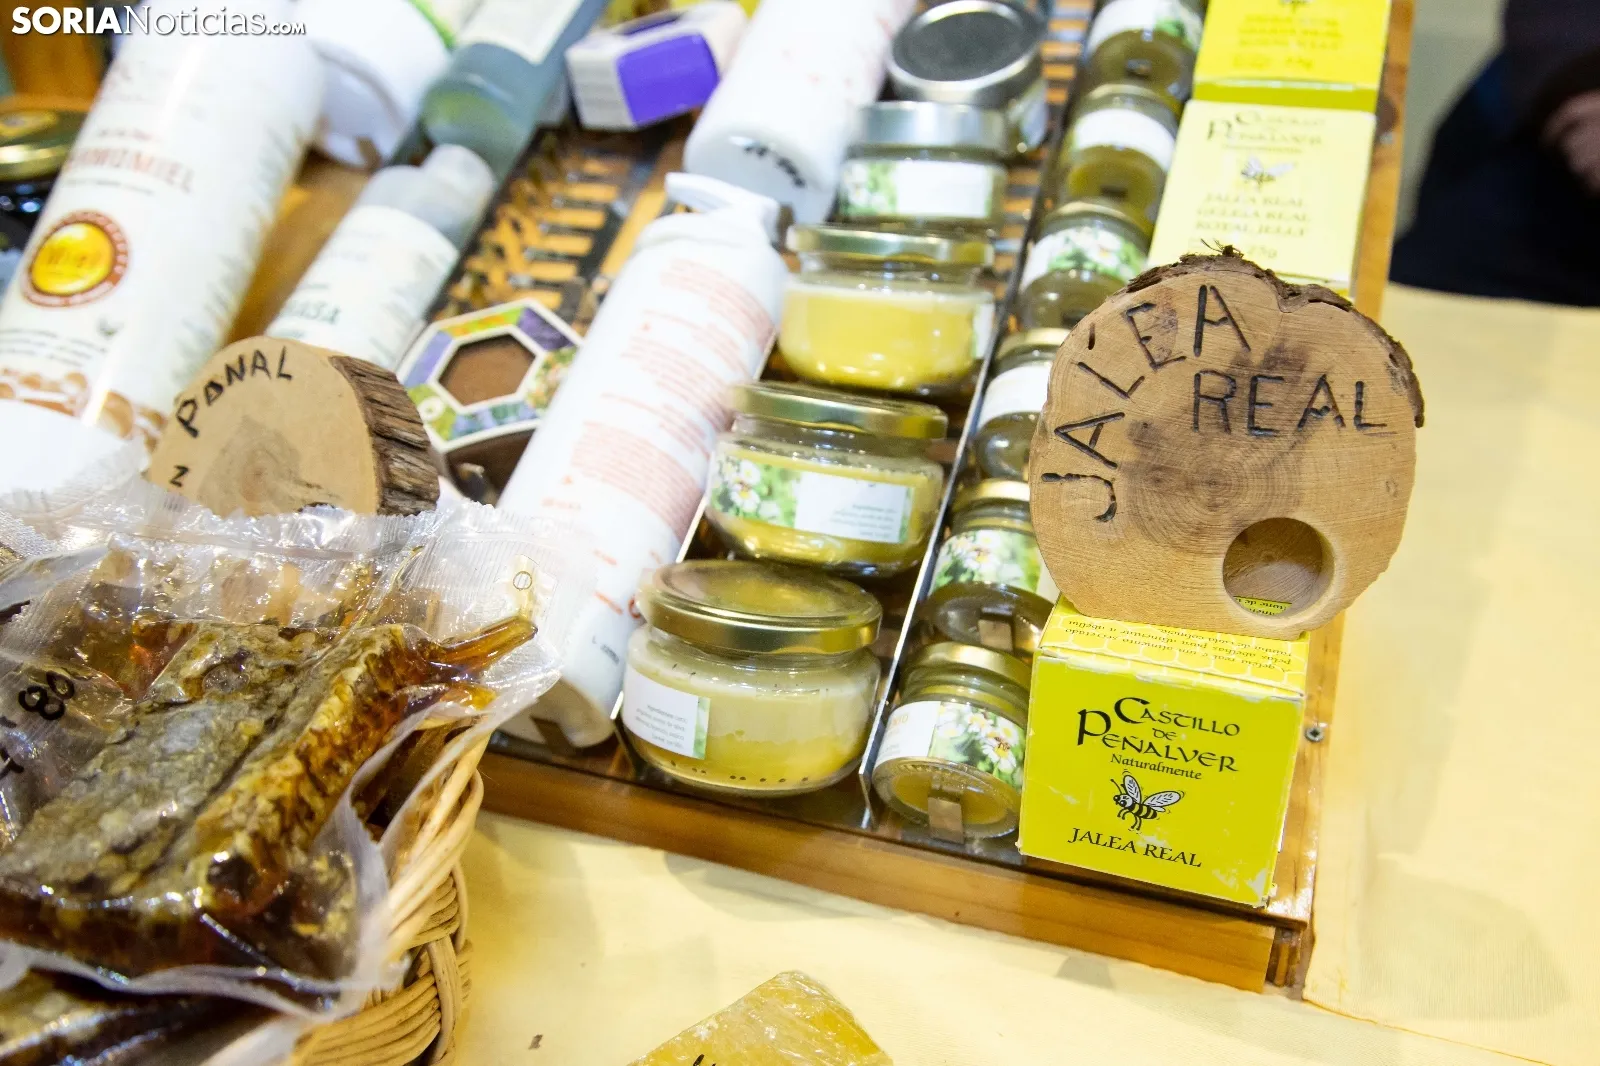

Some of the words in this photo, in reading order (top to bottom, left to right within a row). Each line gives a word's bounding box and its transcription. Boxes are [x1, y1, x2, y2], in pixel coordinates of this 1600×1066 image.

[1041, 284, 1251, 523] JALEA
[1193, 369, 1388, 437] REAL
[1110, 753, 1203, 781] Naturalmente
[1067, 827, 1138, 855] JALEA
[1142, 843, 1203, 868] REAL
